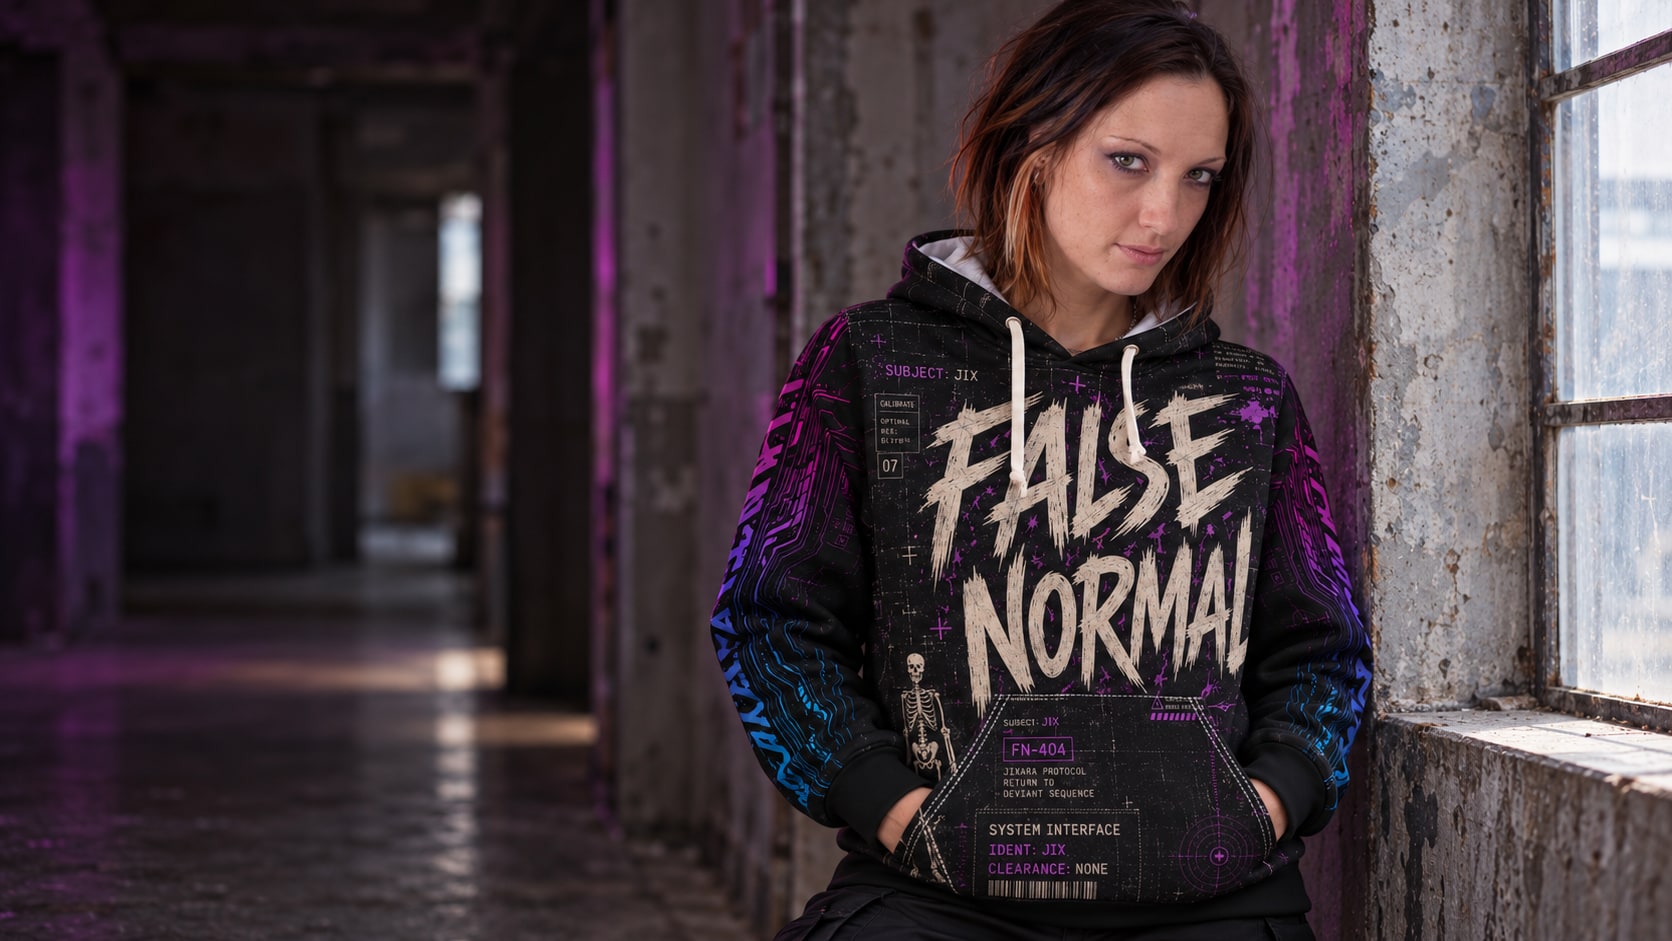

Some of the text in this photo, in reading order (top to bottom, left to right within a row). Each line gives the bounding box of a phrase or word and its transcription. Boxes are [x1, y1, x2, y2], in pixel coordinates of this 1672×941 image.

[885, 364, 978, 381] SUBJECT: JIX
[882, 459, 898, 472] 07
[917, 390, 1254, 594] FALSE
[962, 505, 1252, 720] NORMAL
[1041, 717, 1059, 726] JIX
[1011, 742, 1066, 757] FN-404
[1003, 767, 1087, 776] JIXARA PROTOCOL
[1003, 778, 1055, 787] RETURN TO
[1003, 789, 1095, 798] DEVIANT SEQUENCE
[989, 823, 1121, 836] SYSTEM INTERFACE
[989, 843, 1066, 856] IDENT: JIX
[988, 862, 1108, 875] CLEARANCE: NONE
